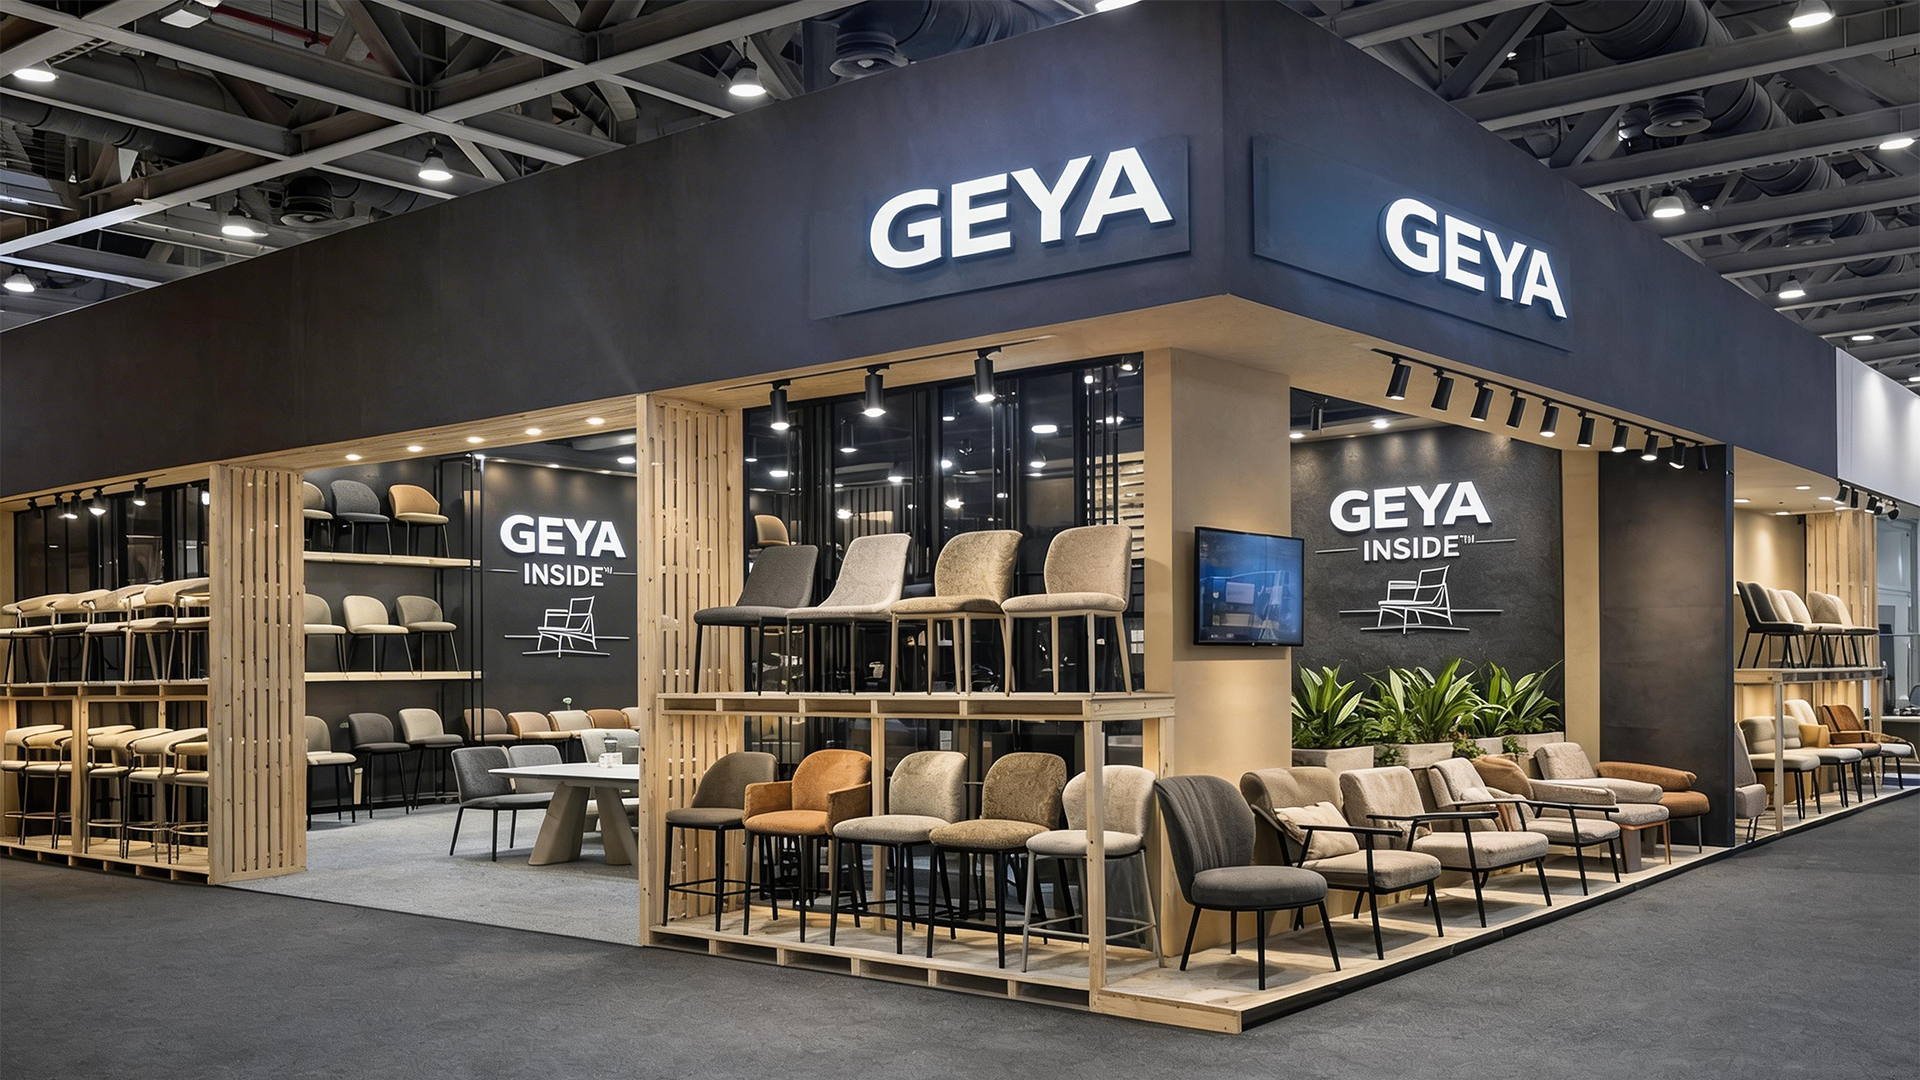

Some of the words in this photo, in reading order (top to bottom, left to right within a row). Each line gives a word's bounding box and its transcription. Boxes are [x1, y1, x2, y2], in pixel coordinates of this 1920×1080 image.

[870, 147, 1173, 269] GEYA
[1385, 198, 1568, 319] GEYA
[500, 514, 627, 558] GEYA
[1329, 481, 1492, 532] GEYA
